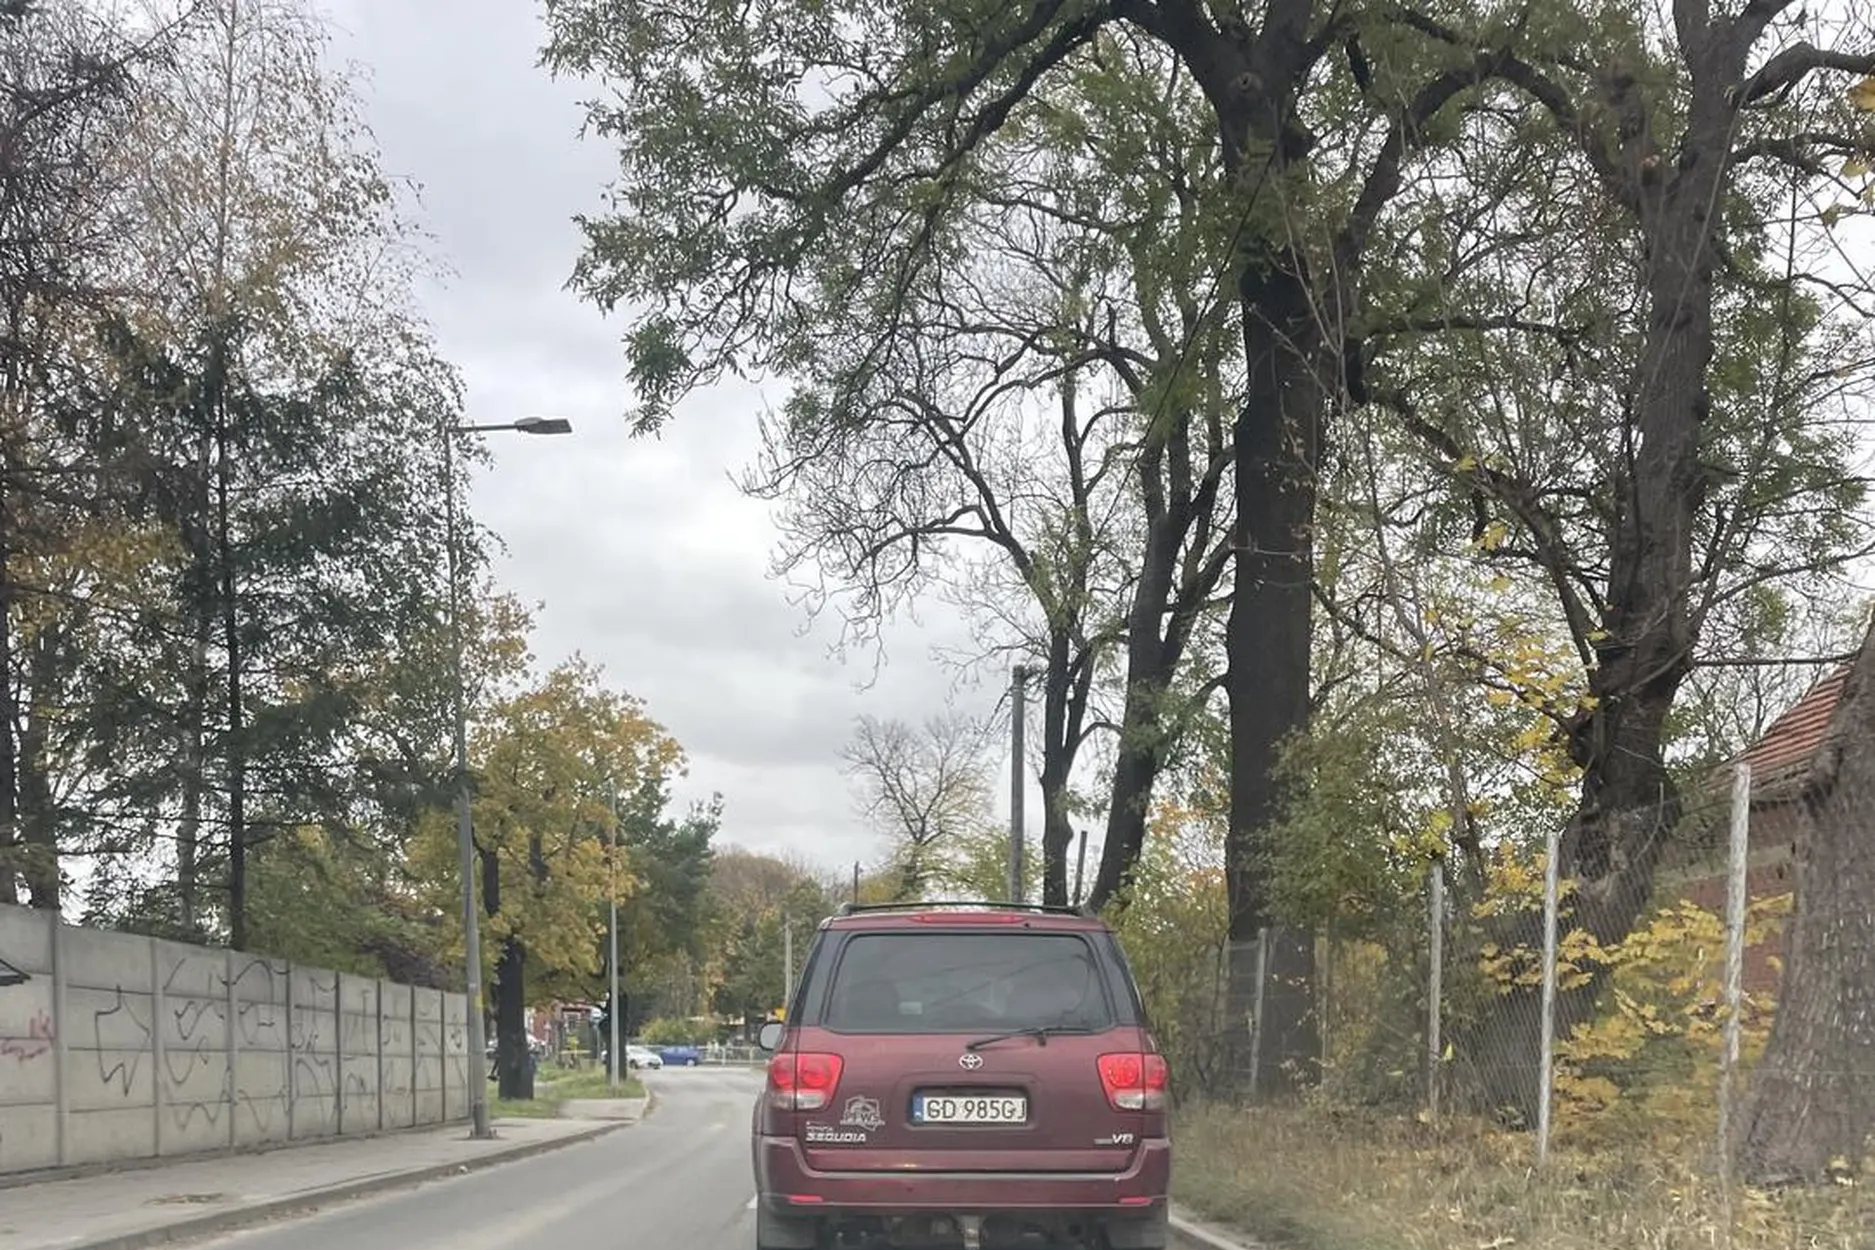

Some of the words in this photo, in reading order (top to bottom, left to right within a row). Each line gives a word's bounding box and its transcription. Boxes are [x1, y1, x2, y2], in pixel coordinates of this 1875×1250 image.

[927, 1100, 956, 1119] GD
[964, 1100, 1025, 1119] 985GJ
[806, 1132, 866, 1142] SEQUOIA
